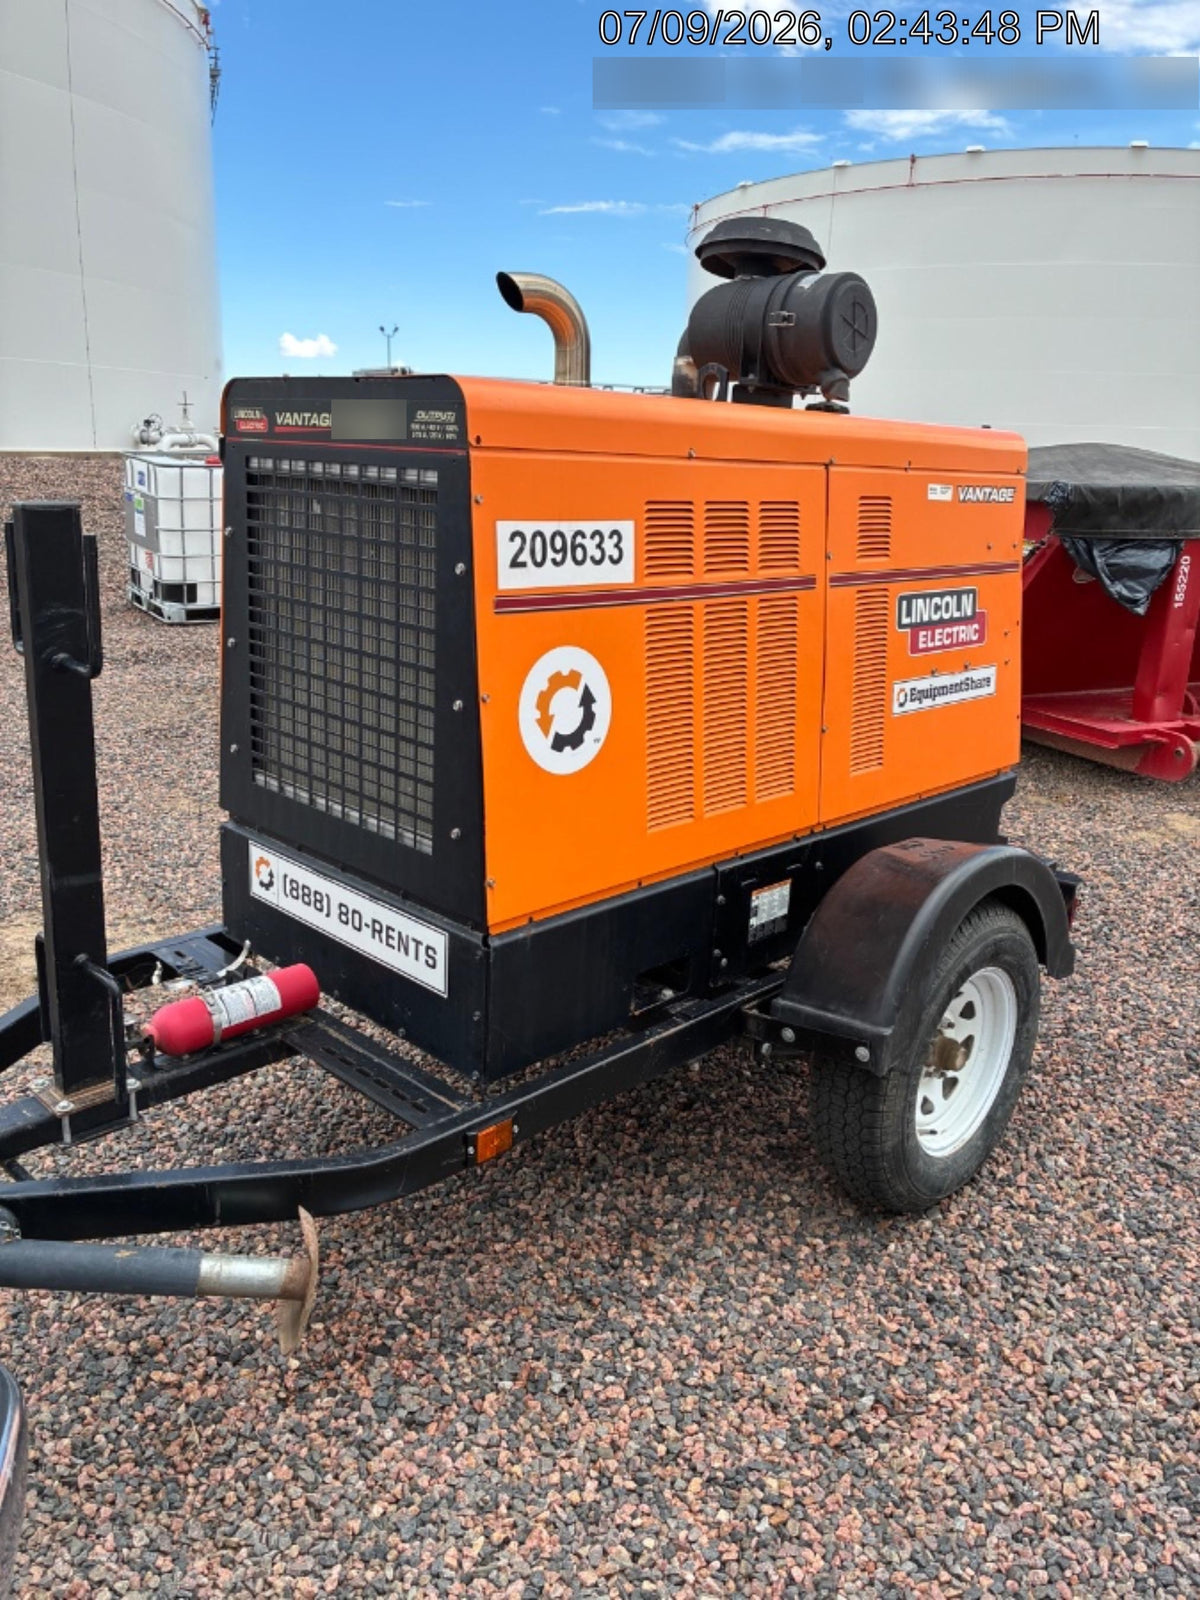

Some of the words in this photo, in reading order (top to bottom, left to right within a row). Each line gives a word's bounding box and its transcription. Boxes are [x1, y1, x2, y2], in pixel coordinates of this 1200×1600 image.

[275, 411, 332, 427] VANTAG
[957, 485, 1016, 503] VANTAGE
[508, 528, 624, 569] 209633
[1173, 555, 1191, 609] 155220
[901, 592, 974, 625] LINCOLN
[918, 622, 980, 649] ELECTRIC
[909, 676, 992, 704] EquipmentShare
[283, 873, 332, 918] (888)
[338, 903, 438, 970] 80-RENTS
